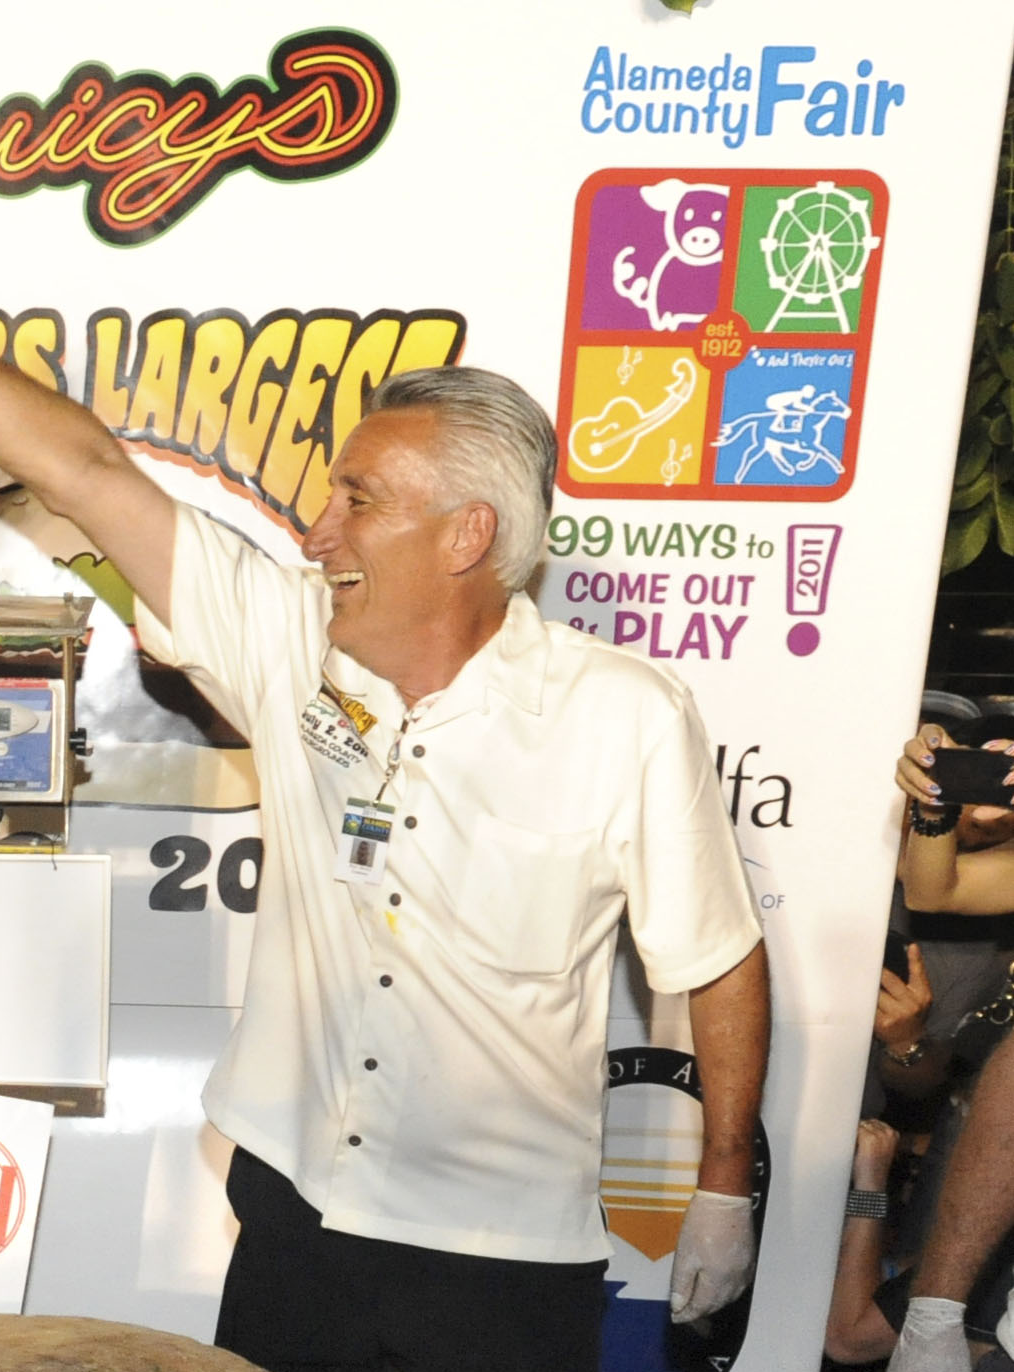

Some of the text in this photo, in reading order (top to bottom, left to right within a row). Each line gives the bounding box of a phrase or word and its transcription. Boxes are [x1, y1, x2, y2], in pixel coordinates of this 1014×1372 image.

[583, 46, 752, 92] Alameda
[754, 46, 905, 137] Fair
[580, 89, 749, 149] County
[701, 338, 742, 357] 1912
[706, 320, 739, 337] est.
[547, 515, 774, 560] 99 WAYS to
[566, 571, 756, 607] COME OUT
[794, 536, 824, 597] 2011
[613, 611, 748, 660] PLAY
[149, 835, 264, 913] 20
[760, 893, 786, 909] OF
